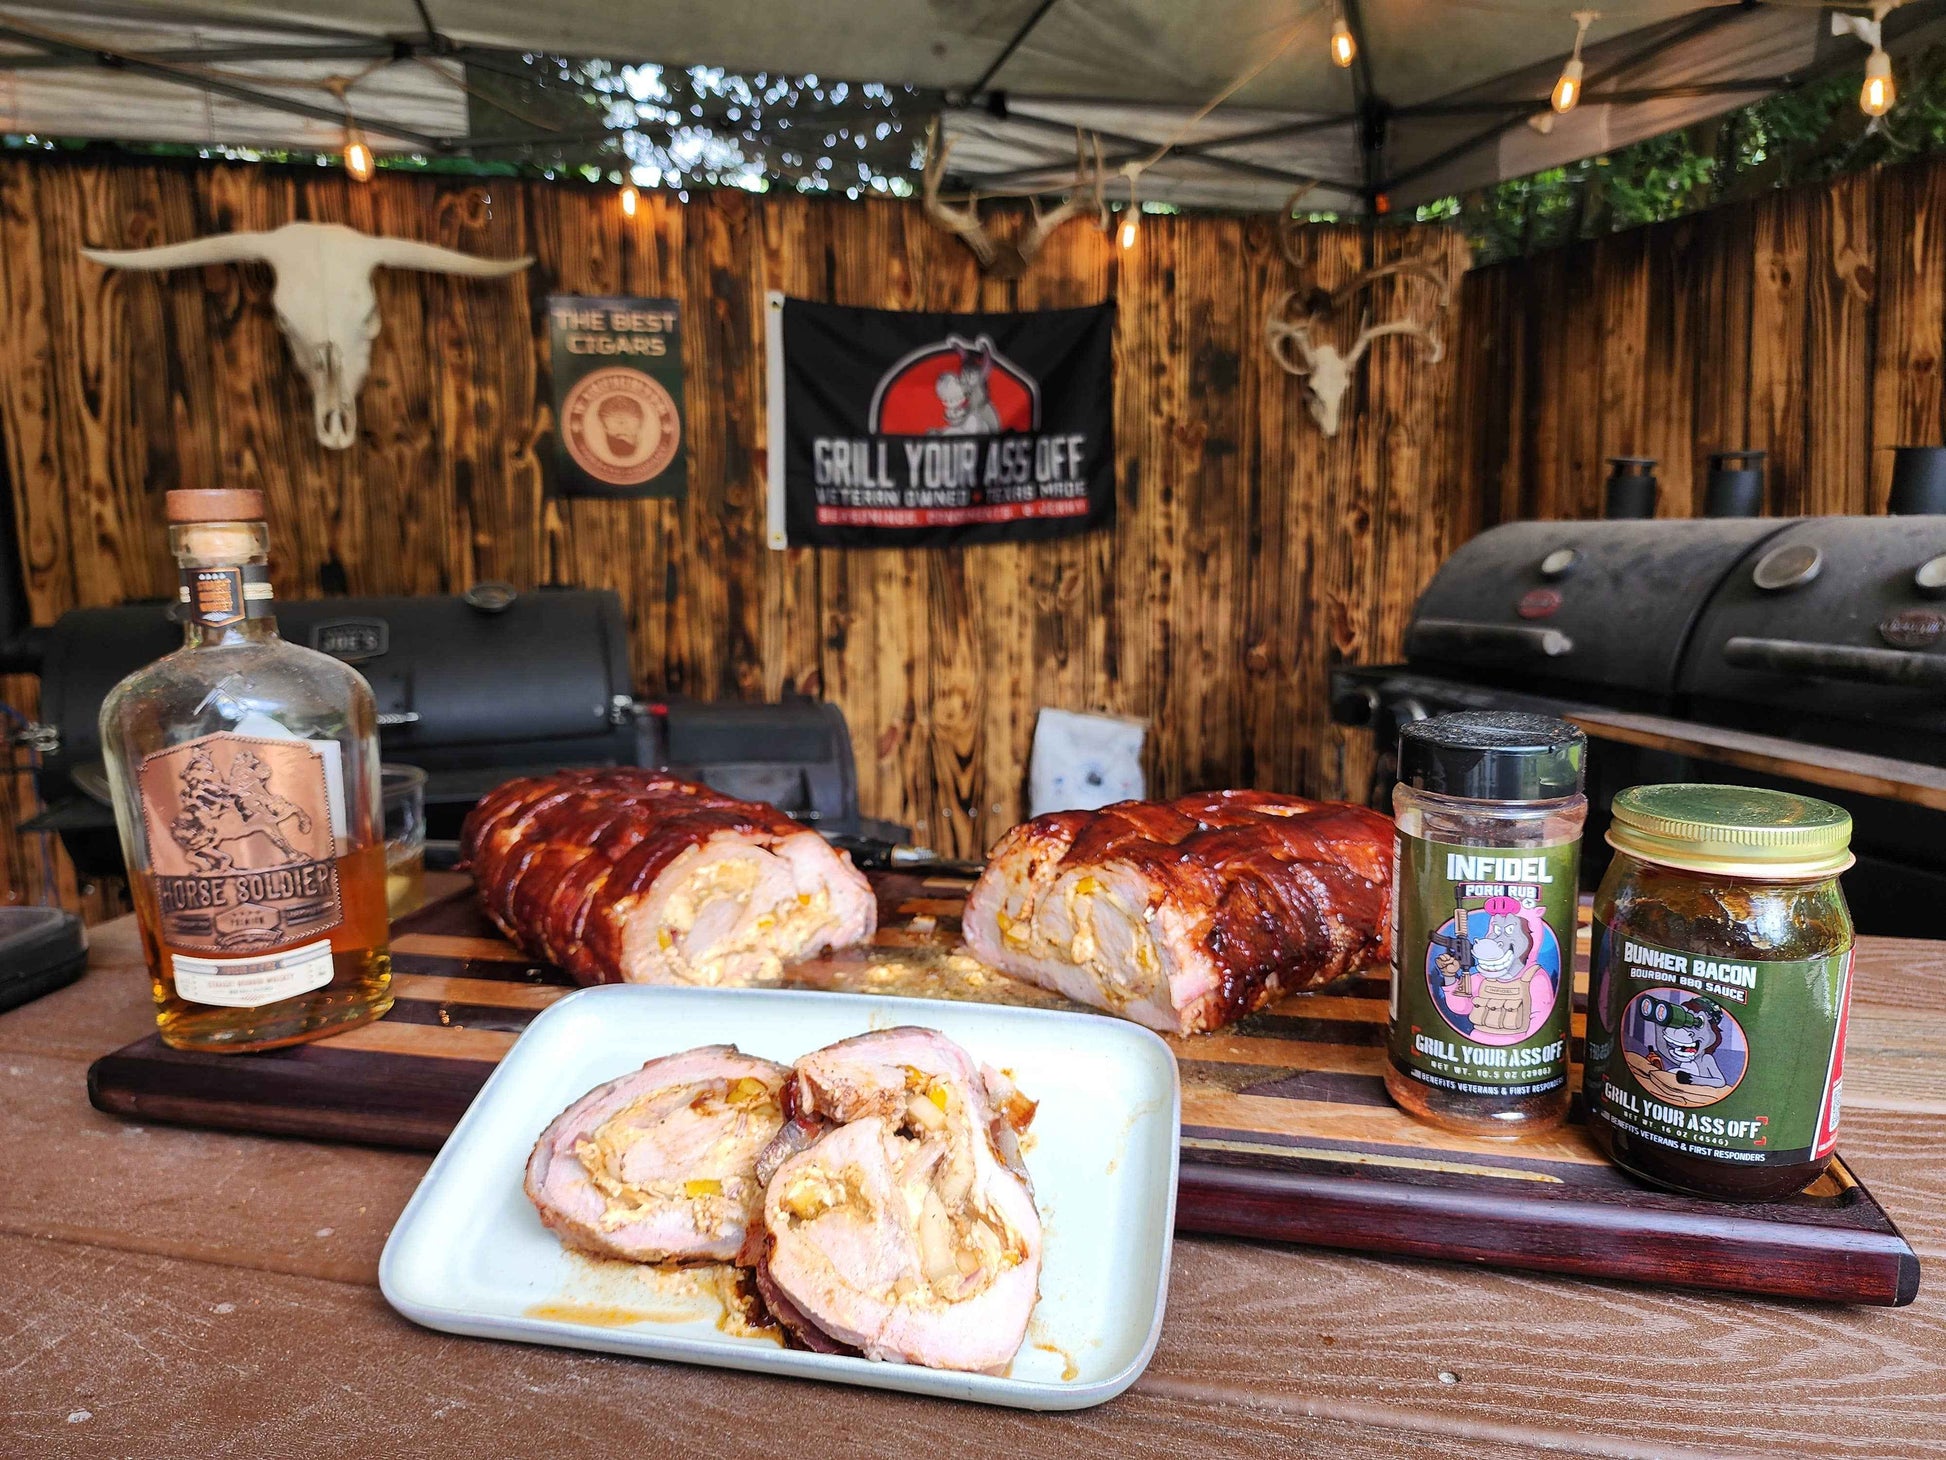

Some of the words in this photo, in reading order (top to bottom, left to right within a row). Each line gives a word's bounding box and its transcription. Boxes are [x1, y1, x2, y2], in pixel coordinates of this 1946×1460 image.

[551, 307, 606, 331] THE
[610, 310, 677, 333] BEST
[565, 333, 666, 356] CIGARS
[814, 437, 895, 488] GRILL
[904, 440, 978, 489] YOUR
[984, 440, 1033, 487] ASS
[1035, 434, 1085, 482] OFF
[815, 487, 900, 507] VETERAN
[903, 489, 970, 507] OWNED
[1040, 480, 1086, 498] MADE
[1446, 853, 1553, 884] INFIDEL
[163, 877, 227, 912] HORSE
[236, 862, 331, 902] SOLDIER
[1507, 886, 1538, 899] RUB
[1624, 941, 1687, 974] BUNKER
[1692, 960, 1757, 989] BACON
[1630, 968, 1676, 983] BOURBON
[1680, 976, 1703, 990] BBQ
[1705, 982, 1745, 1002] SAUCE
[1415, 1034, 1459, 1063] GRILL
[1461, 1045, 1507, 1068] YOUR
[1508, 1046, 1542, 1068] ASS
[1542, 1039, 1564, 1063] OFF
[1421, 1073, 1456, 1090] BENEFITS
[1457, 1082, 1499, 1096] VETERANS
[1501, 1087, 1508, 1096] &
[1509, 1085, 1531, 1096] FIRST
[1430, 1060, 1449, 1072] NET
[1454, 1066, 1471, 1076] WT.
[1477, 1069, 1500, 1079] 10.5
[1504, 1071, 1518, 1080] OZ
[1604, 1082, 1640, 1114] GRILL
[1642, 1099, 1685, 1128] YOUR
[1686, 1113, 1725, 1136] ASS
[1727, 1120, 1762, 1139] OFF
[1610, 1114, 1640, 1136] BENEFITS
[1640, 1129, 1679, 1149] VETERANS
[1679, 1142, 1687, 1151] &
[1689, 1144, 1713, 1156] FIRST
[1714, 1150, 1766, 1162] RESPONDERS
[1624, 1111, 1638, 1122] NET
[1661, 1125, 1672, 1134] 16
[1676, 1130, 1688, 1139] OZ
[1693, 1134, 1729, 1147] (454G)
